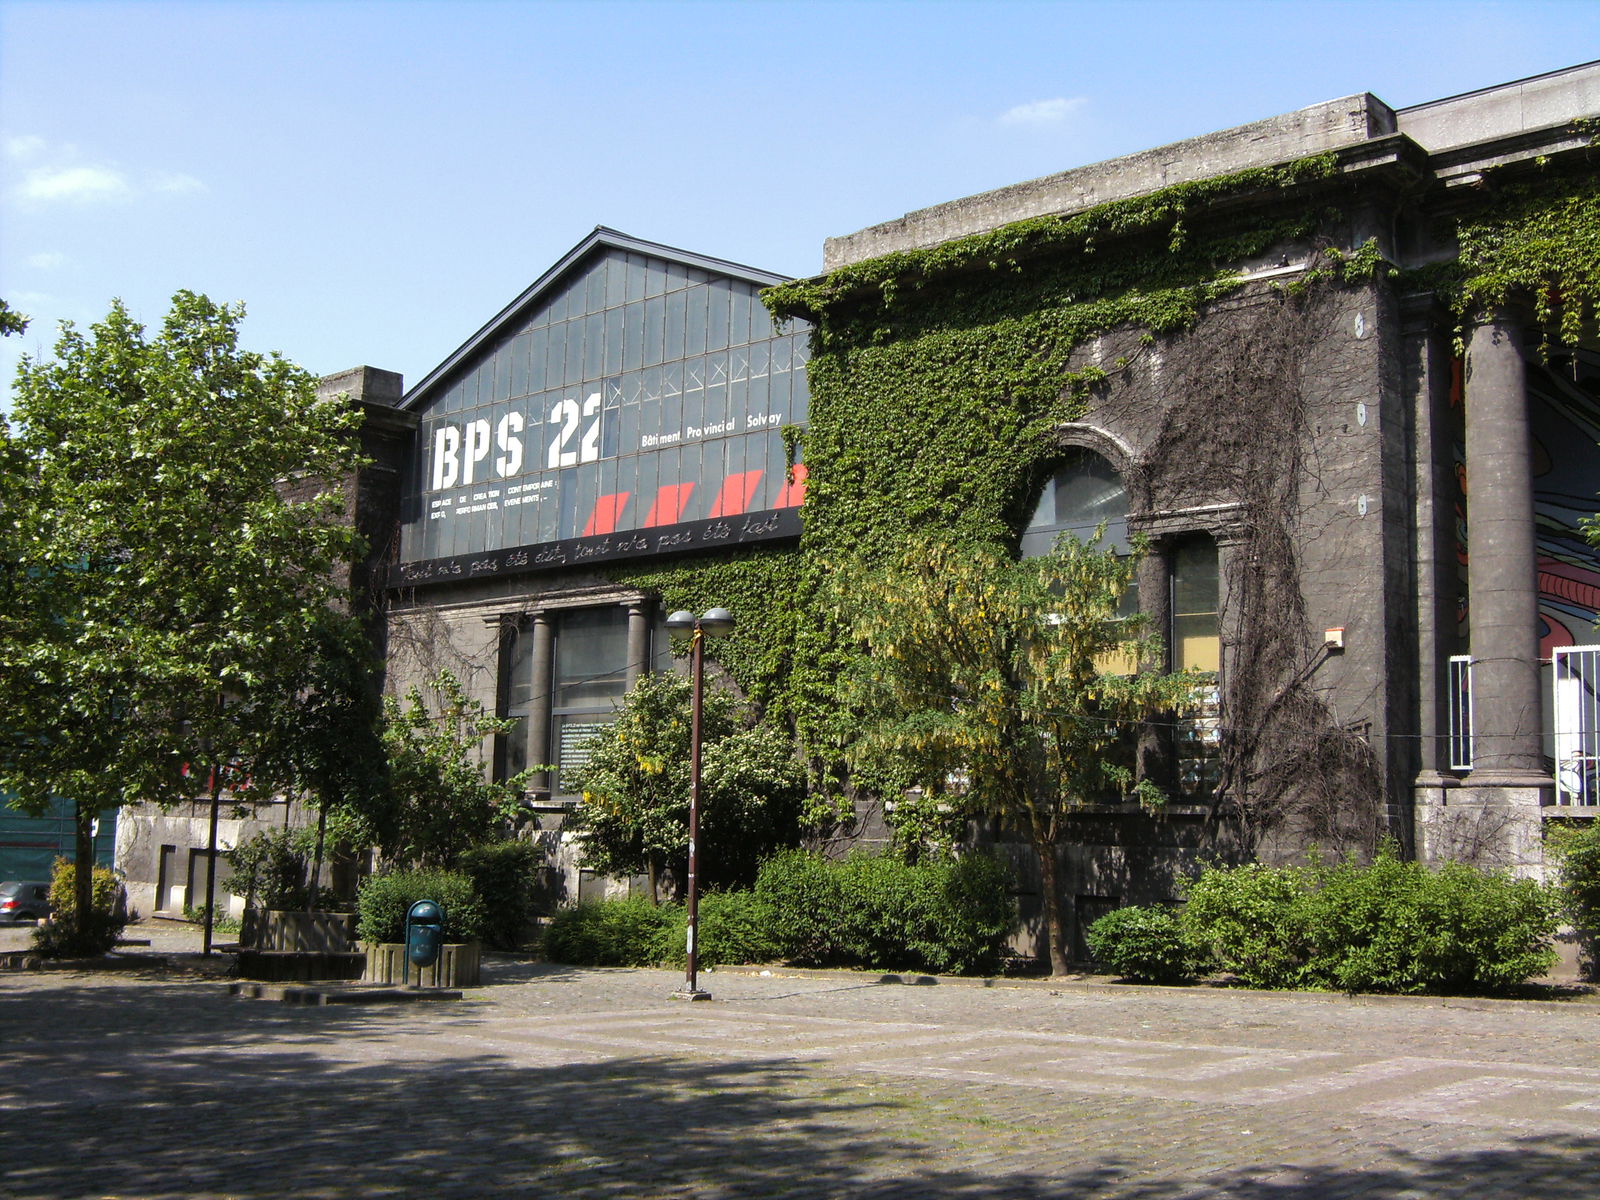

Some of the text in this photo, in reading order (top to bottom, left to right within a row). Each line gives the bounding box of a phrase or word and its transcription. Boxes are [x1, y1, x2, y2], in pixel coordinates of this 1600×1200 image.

[433, 392, 601, 490] BPS 22
[642, 412, 782, 447] Bâtiment Provincial Solvay
[431, 498, 452, 509] ESPACE
[459, 496, 467, 504] DE
[616, 534, 648, 552] n'a
[657, 530, 693, 552] pas
[703, 521, 731, 540] été
[739, 512, 779, 542] fait
